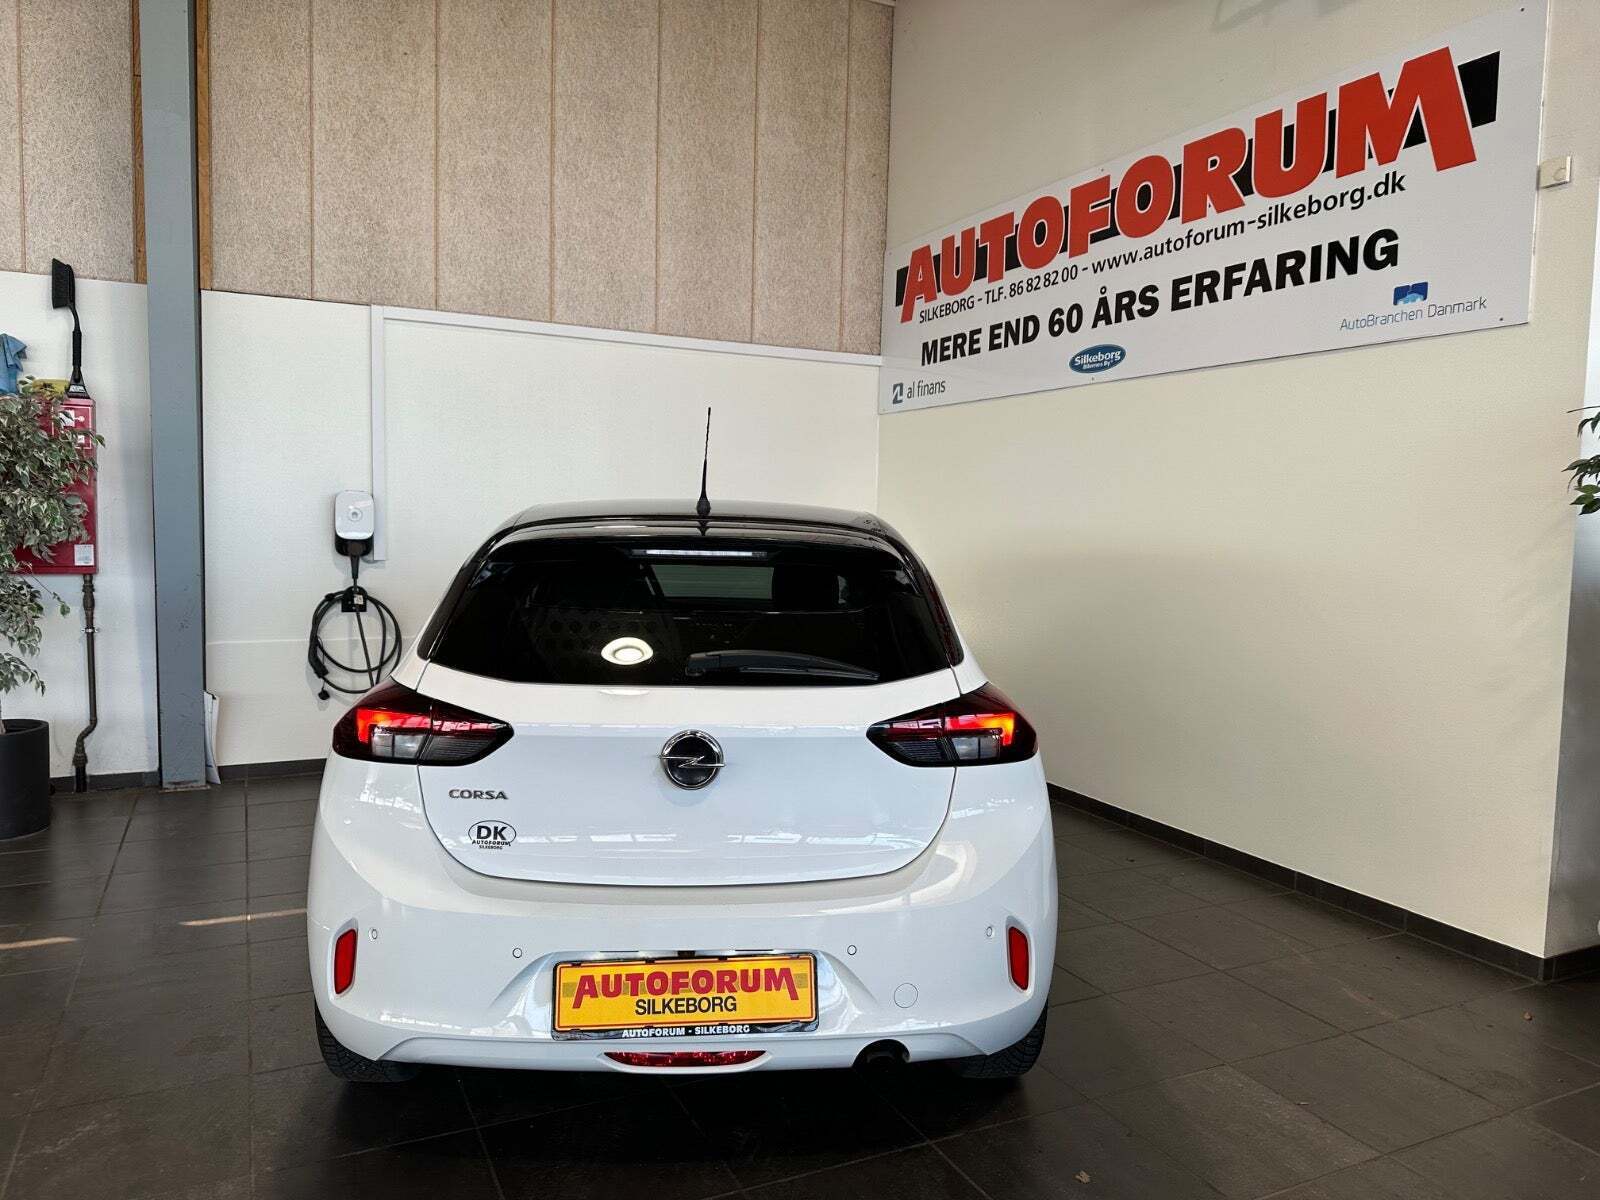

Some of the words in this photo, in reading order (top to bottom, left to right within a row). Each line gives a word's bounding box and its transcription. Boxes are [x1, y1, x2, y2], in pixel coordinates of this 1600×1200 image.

[899, 46, 1477, 323] AUTOFORUM
[919, 295, 975, 324] SILKEBORG
[984, 286, 1007, 304] TLF.
[1091, 170, 1406, 274] www.autoforum-silkeborg.dk
[920, 328, 982, 367] MERE
[988, 314, 1041, 352] END
[1048, 302, 1083, 338] 60
[1091, 285, 1160, 329] ÅRS
[1170, 228, 1400, 312] ERFARING
[1340, 308, 1423, 331] AutoBranchen
[1427, 296, 1488, 318] Danmark
[1073, 350, 1122, 366] Silkeborg
[906, 381, 915, 399] al
[917, 380, 946, 398] finans
[448, 788, 508, 800] CORSA
[476, 825, 507, 841] DK
[471, 839, 512, 847] AUTOFORUM
[571, 967, 800, 1009] AUTOFORUM
[635, 996, 737, 1016] SILKEBORG
[621, 1027, 686, 1039] AUTOFORUM
[694, 1024, 750, 1036] SILKEBORG
